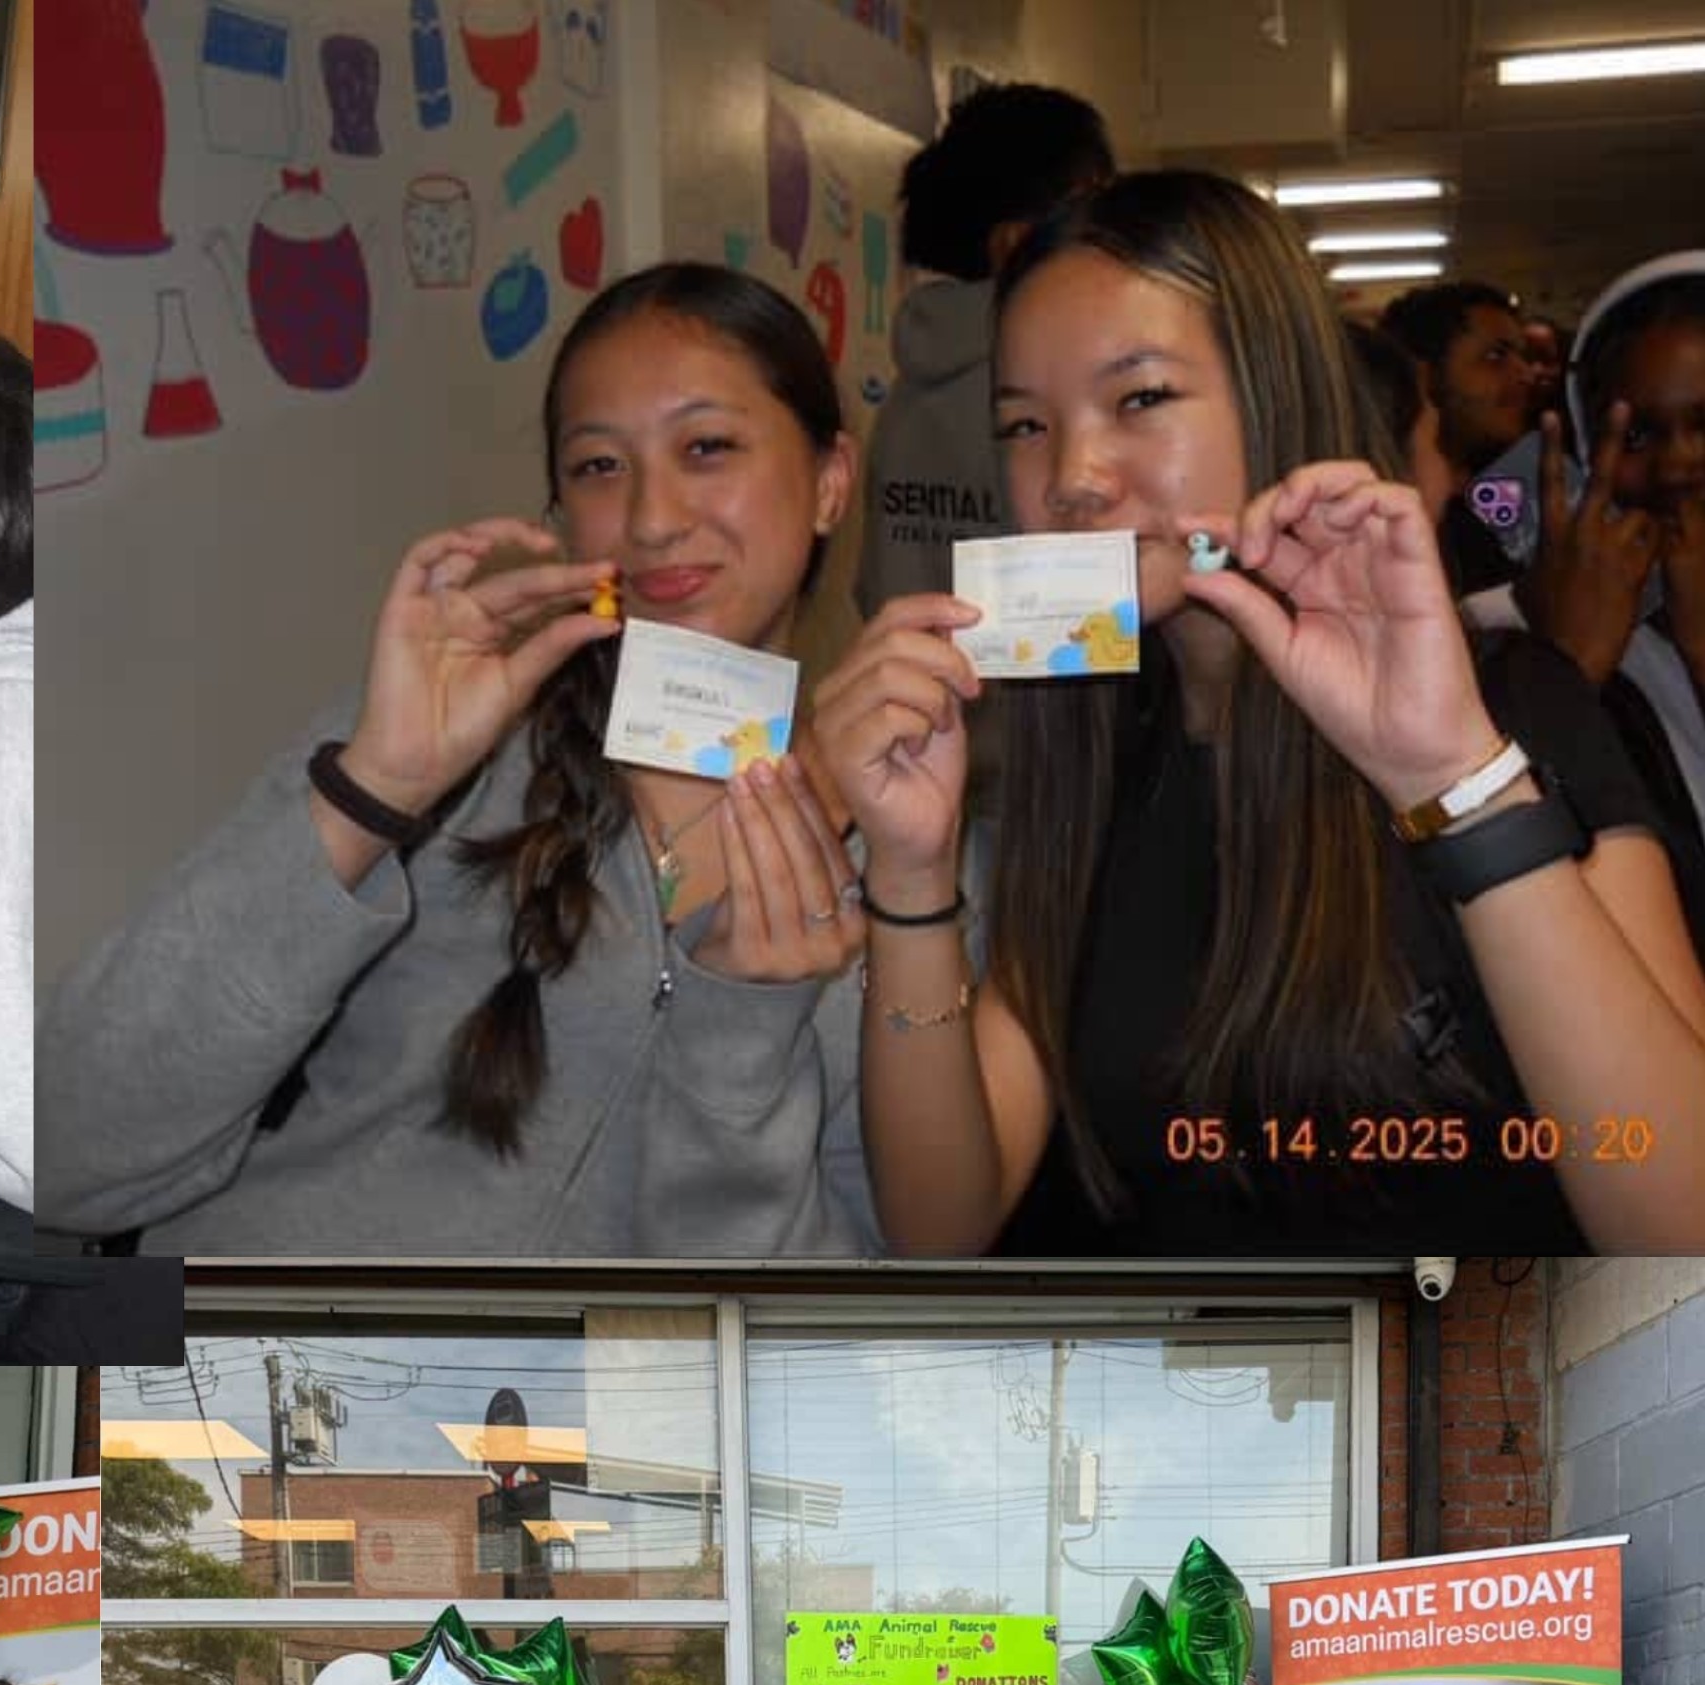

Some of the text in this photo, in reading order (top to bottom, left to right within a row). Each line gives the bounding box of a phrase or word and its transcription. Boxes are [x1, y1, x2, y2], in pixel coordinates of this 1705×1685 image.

[1288, 1566, 1594, 1629] DONATE TODAY!
[823, 1618, 997, 1636] AMA Animal Rescue
[1290, 1613, 1593, 1660] amaanimalrescue.org
